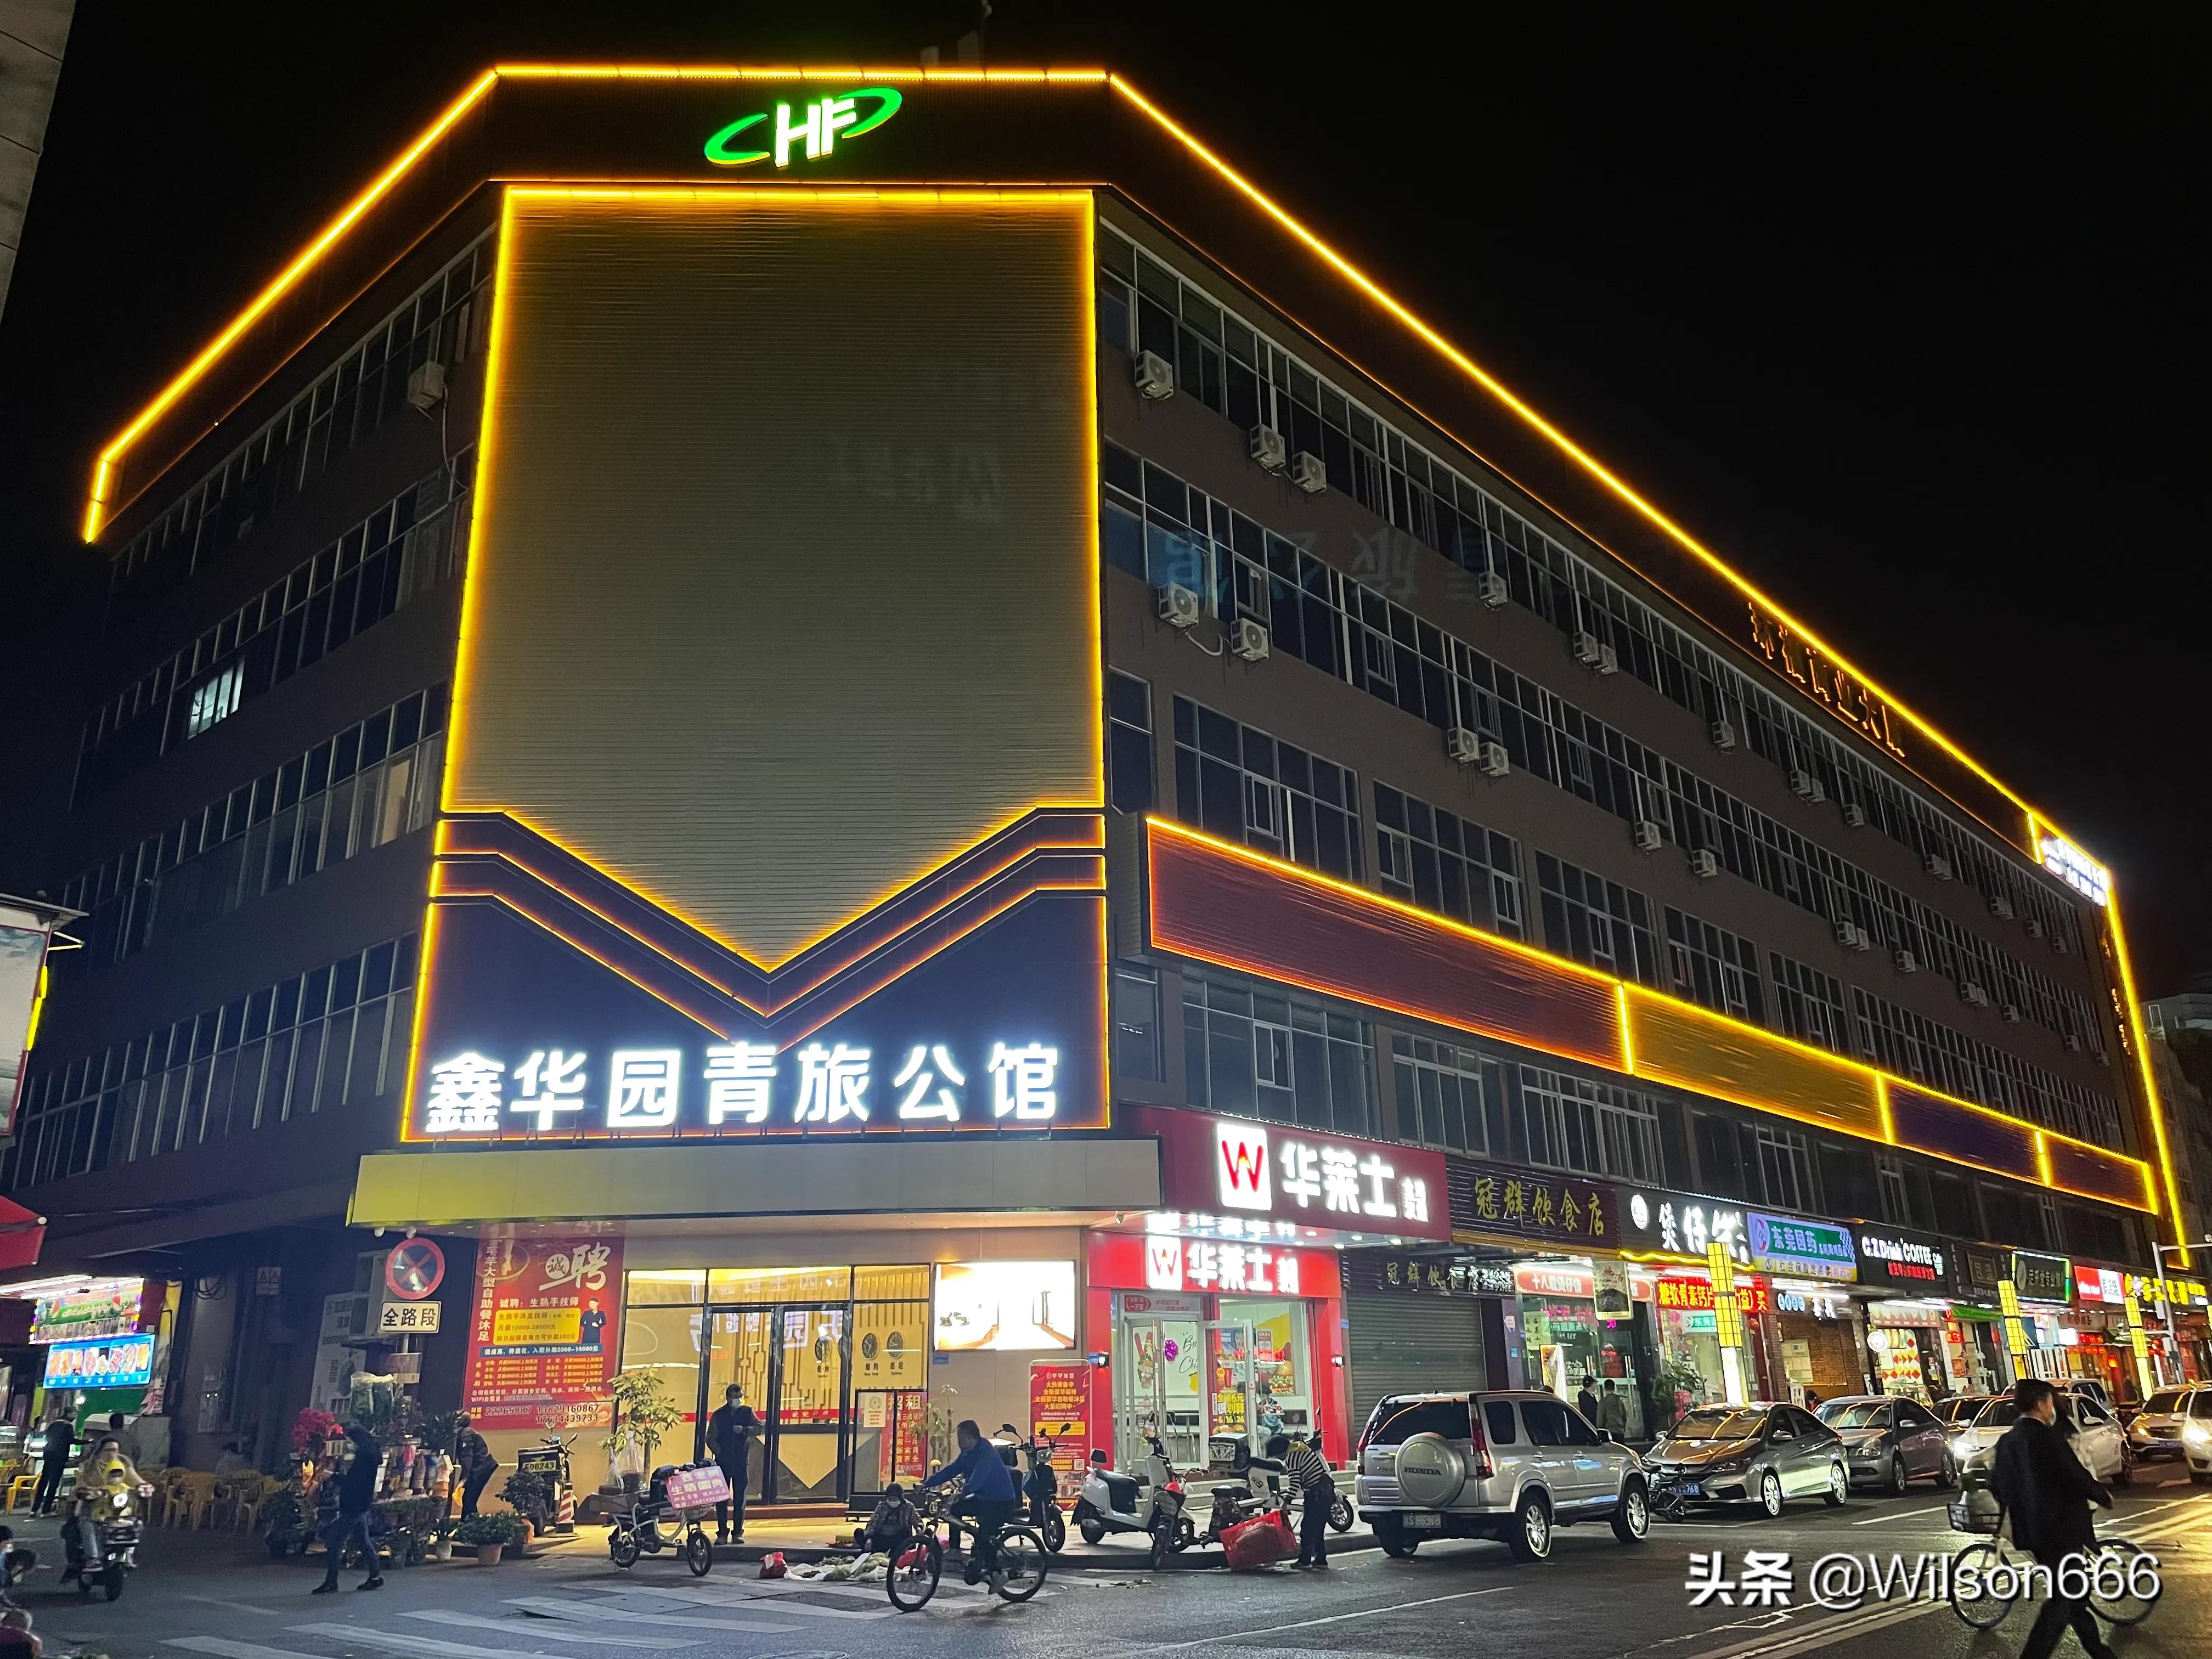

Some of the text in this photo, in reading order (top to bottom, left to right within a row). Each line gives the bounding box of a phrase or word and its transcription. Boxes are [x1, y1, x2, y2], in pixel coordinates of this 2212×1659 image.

[426, 1042, 1059, 1133] 鑫华园青旅公馆
[1280, 1142, 1397, 1218] 华莱士
[1771, 1226, 1817, 1254] 东莞国药
[1187, 1243, 1273, 1291] 华莱士
[382, 1307, 438, 1328] 全路段
[1404, 1466, 1442, 1475] HONDA
